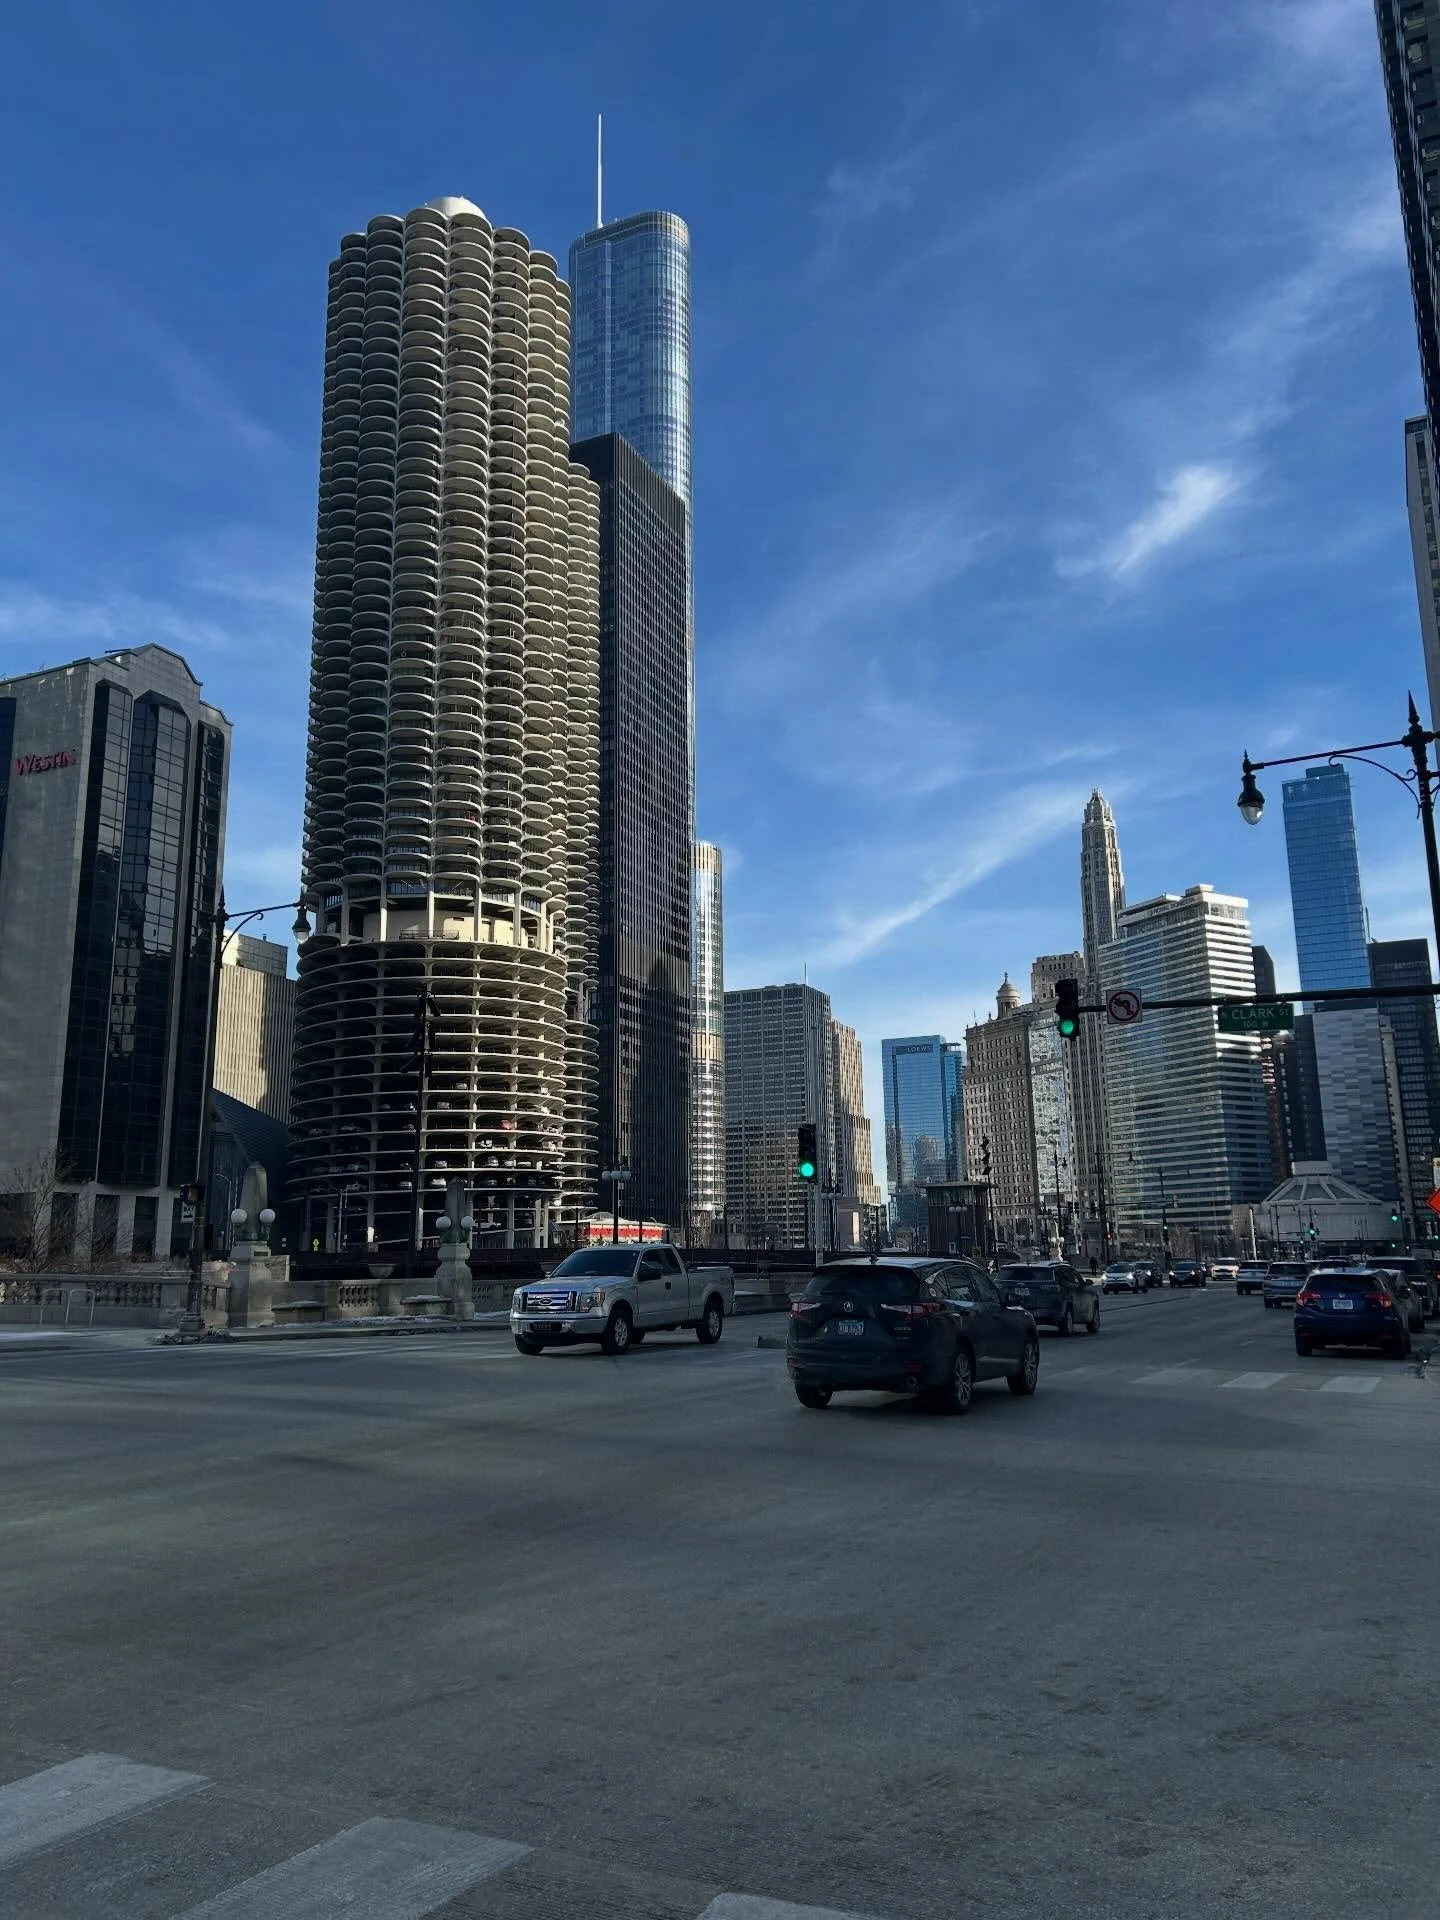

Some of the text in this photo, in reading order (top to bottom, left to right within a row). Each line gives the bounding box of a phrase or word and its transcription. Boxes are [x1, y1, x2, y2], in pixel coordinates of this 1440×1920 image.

[15, 751, 76, 776] WESTIN
[1231, 1007, 1275, 1020] CLARK
[1279, 1008, 1289, 1016] ST
[907, 1045, 931, 1053] LOEWS
